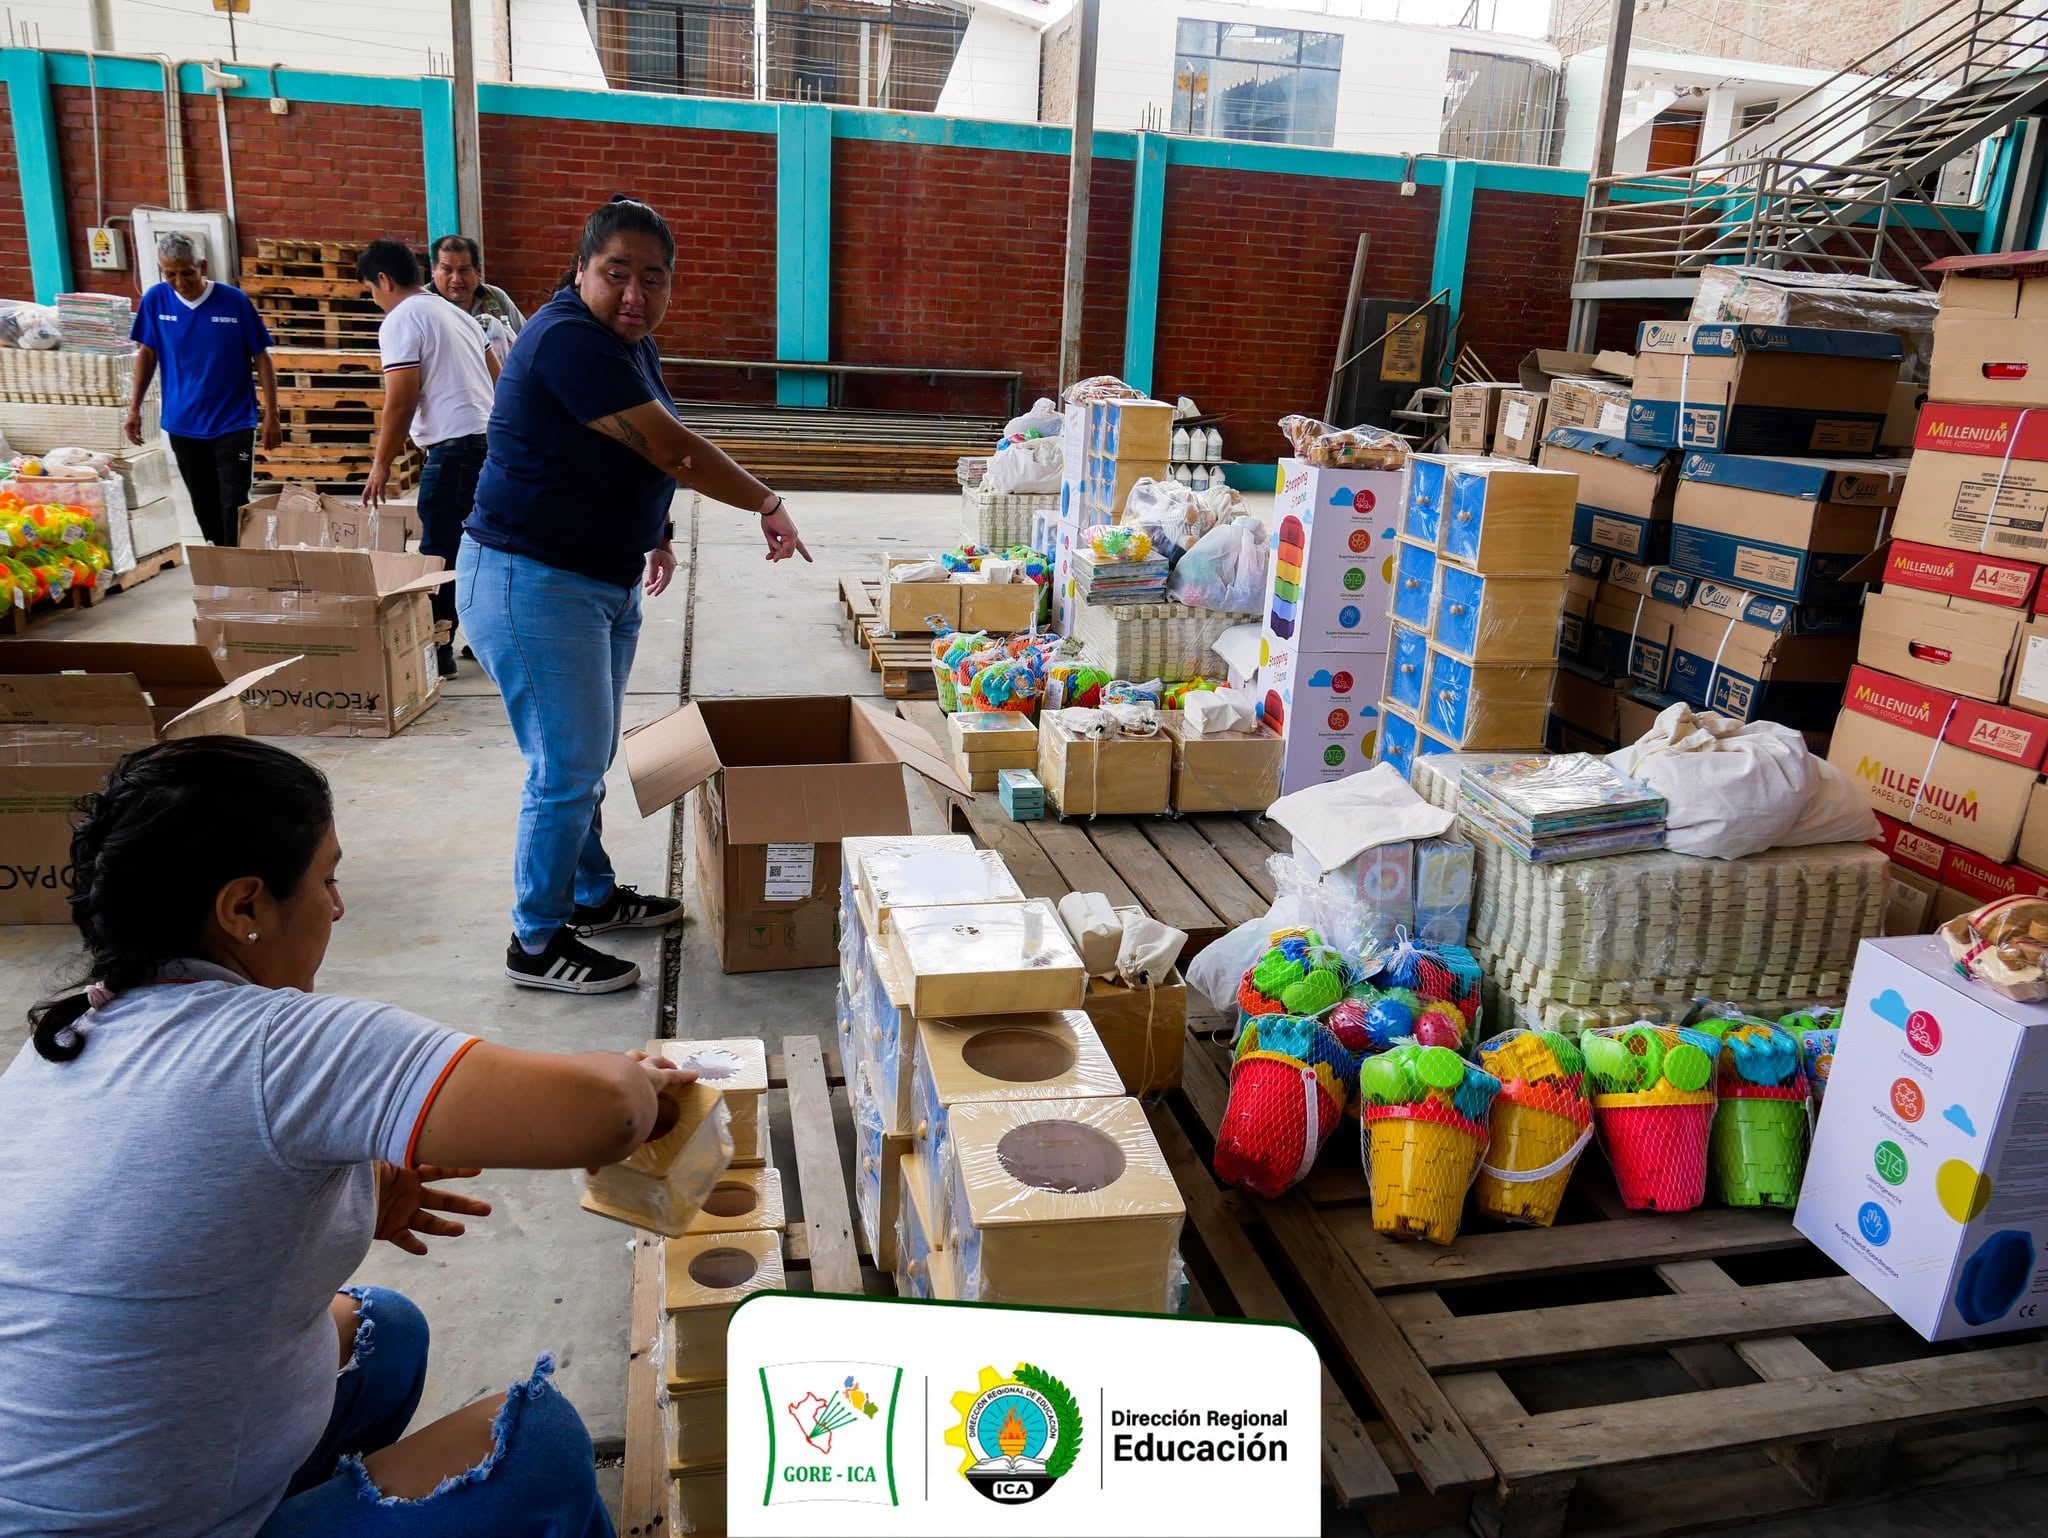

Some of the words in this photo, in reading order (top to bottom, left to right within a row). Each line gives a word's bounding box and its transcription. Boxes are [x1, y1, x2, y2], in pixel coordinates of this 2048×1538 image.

[1927, 421, 2007, 443] MILLENIUM
[1894, 556, 1955, 578] MILLENIUM
[1975, 568, 1999, 586] A4
[1718, 688, 1728, 700] A4
[1854, 685, 1931, 723] MILLENIUM
[1973, 722, 1999, 742] A4
[1856, 755, 1979, 823] MILLENIUM
[1871, 785, 1896, 804] PAPEL
[1898, 798, 1953, 826] FOTOCOPIA
[1897, 834, 1919, 852] A4
[1951, 856, 2016, 893] MILLENIUM
